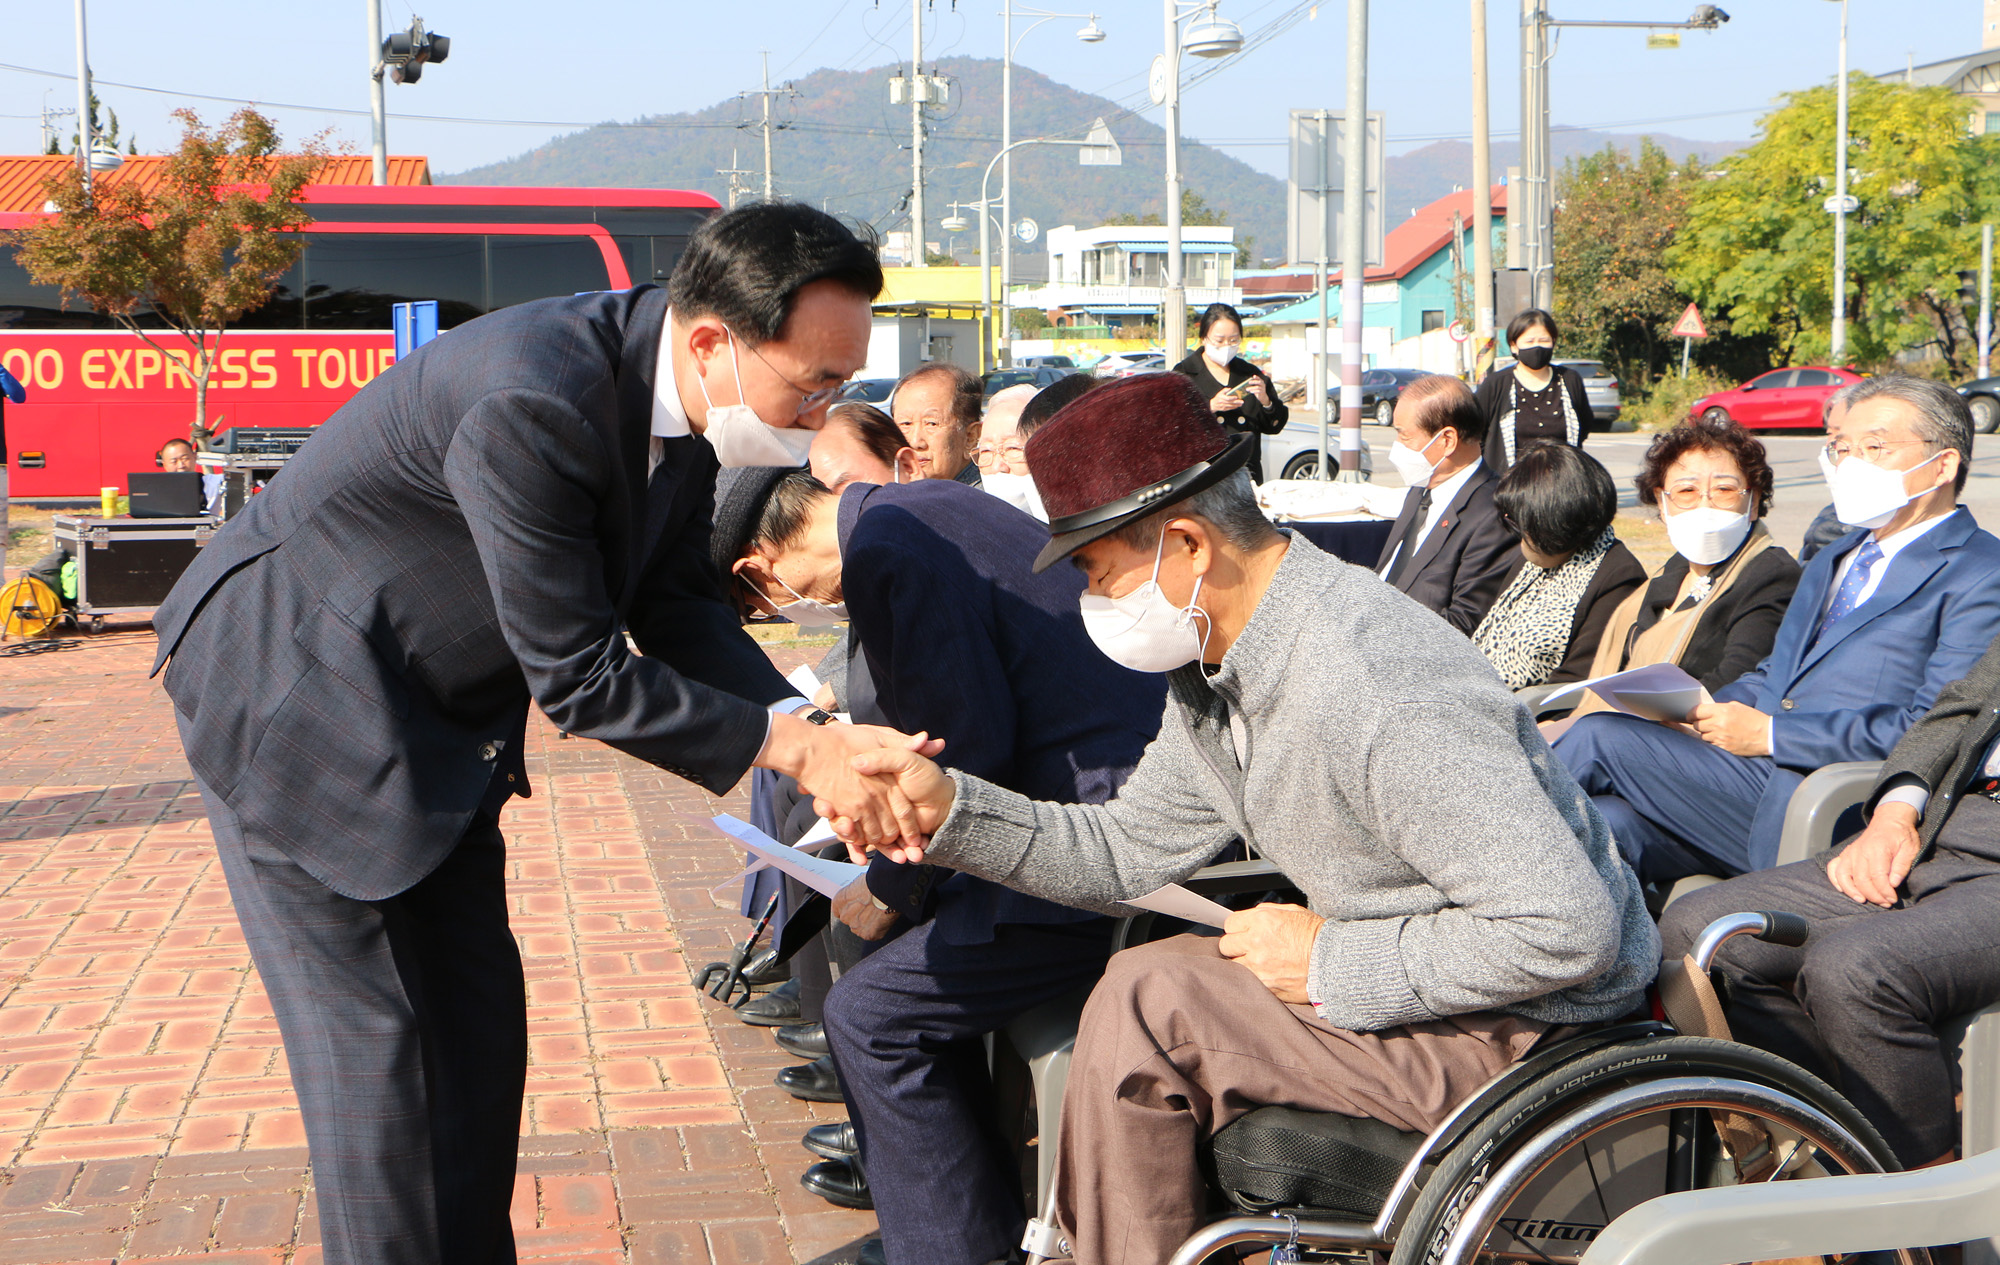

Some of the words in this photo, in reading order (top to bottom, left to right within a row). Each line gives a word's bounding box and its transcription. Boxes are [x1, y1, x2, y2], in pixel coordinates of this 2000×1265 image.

[80, 349, 278, 389] EXPRESS
[1556, 1053, 1668, 1095] MARATHON
[1499, 1094, 1547, 1136] PLUS
